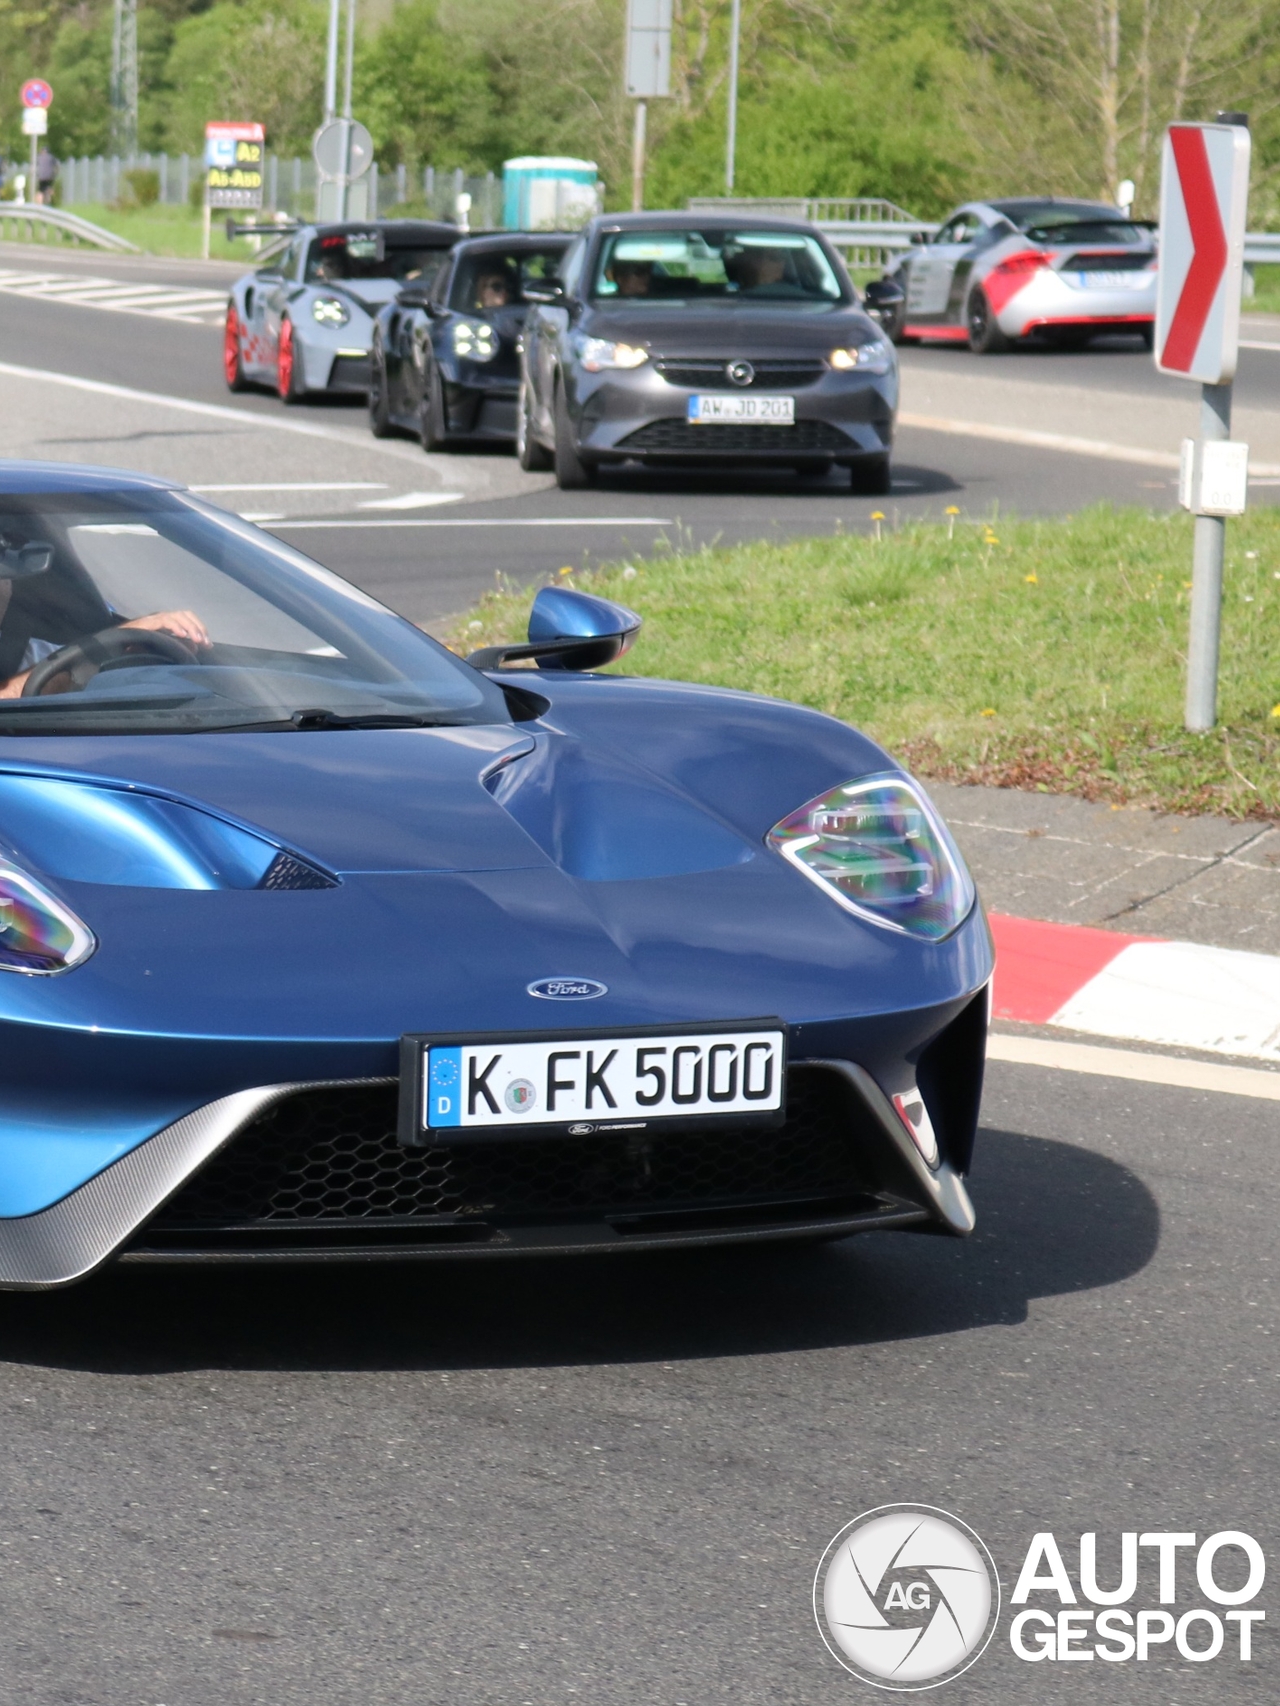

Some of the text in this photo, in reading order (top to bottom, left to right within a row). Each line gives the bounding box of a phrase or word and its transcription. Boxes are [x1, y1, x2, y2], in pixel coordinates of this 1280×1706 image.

[237, 141, 260, 163] A2
[702, 400, 792, 417] AW JD 201
[547, 981, 590, 996] Ford
[437, 1096, 451, 1114] D
[467, 1053, 503, 1115] K
[546, 1048, 618, 1112] FK
[635, 1041, 774, 1107] 5000
